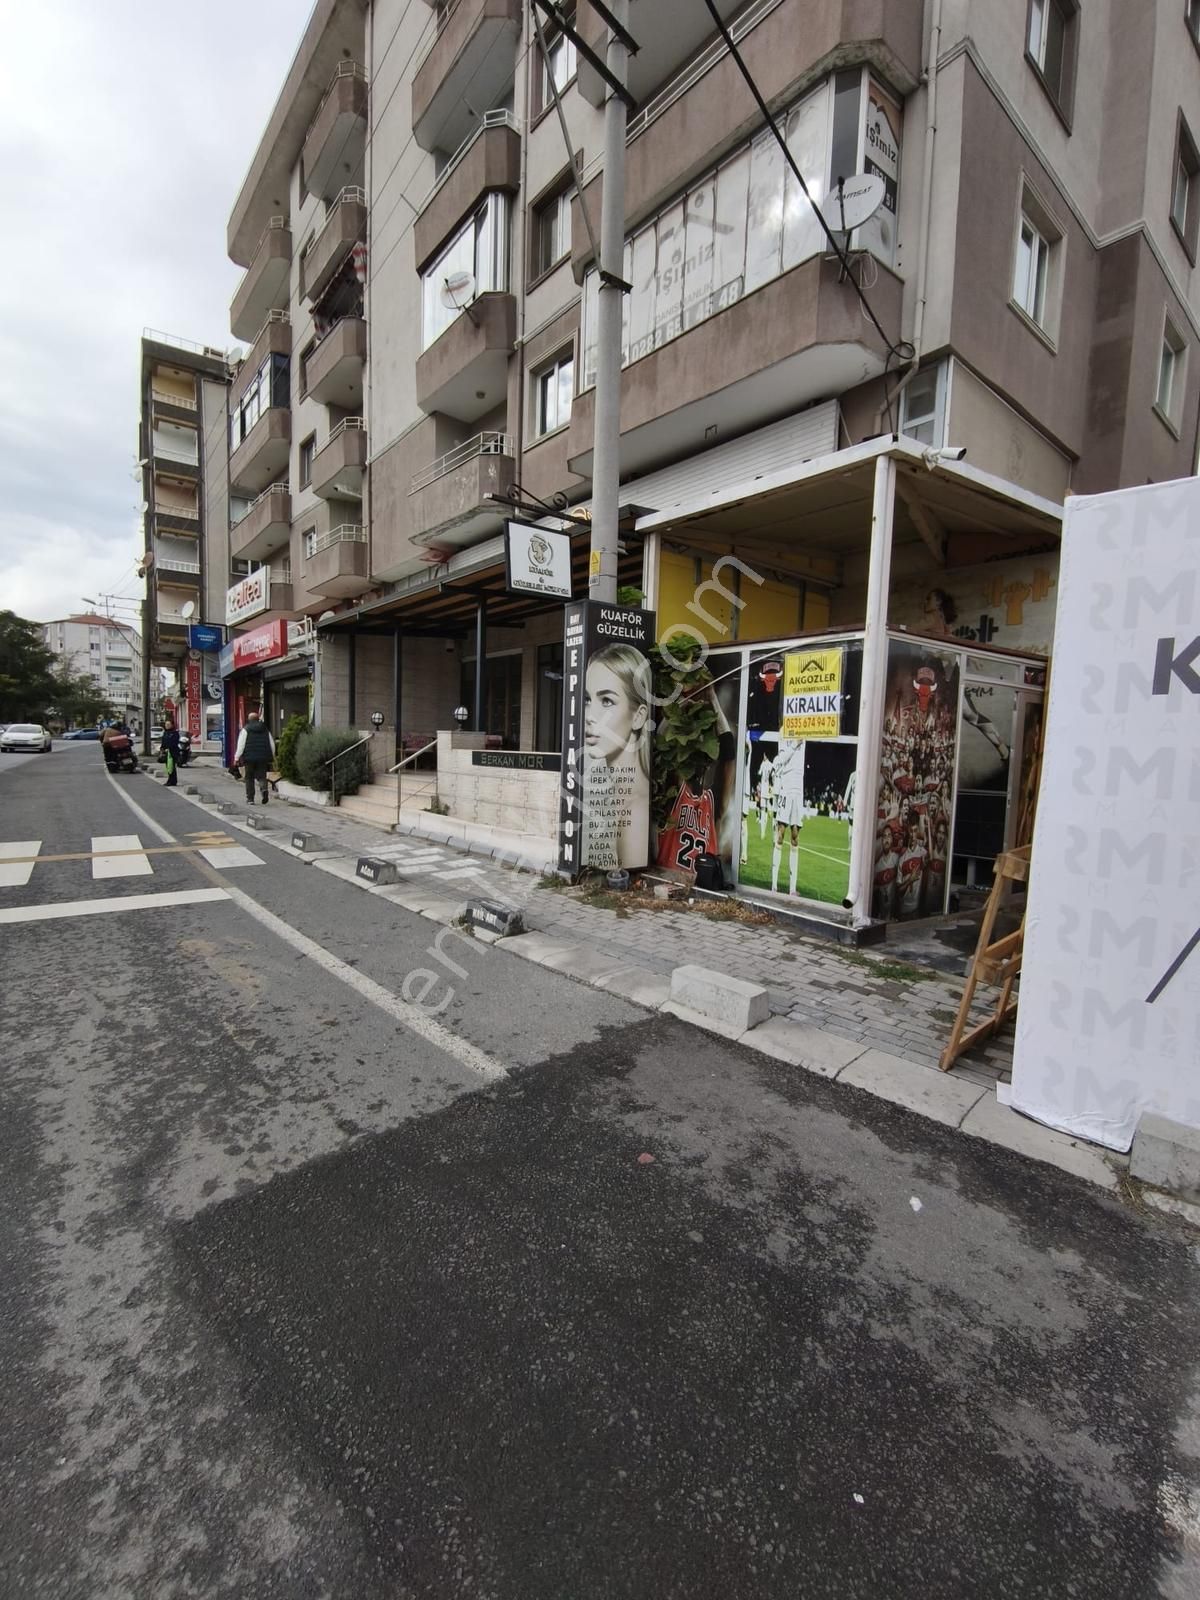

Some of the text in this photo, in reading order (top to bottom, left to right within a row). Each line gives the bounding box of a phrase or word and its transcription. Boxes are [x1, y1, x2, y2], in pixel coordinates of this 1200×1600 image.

[600, 608, 643, 626] KUAFÖR
[596, 622, 646, 640] GÜZELLİK
[786, 717, 802, 729] 0535
[803, 717, 816, 728] 674
[481, 752, 515, 766] SERKAN
[563, 649, 579, 862] EPİLASYON
[610, 798, 626, 806] ART
[607, 820, 632, 828] LAZER
[588, 842, 610, 851] AĞDA
